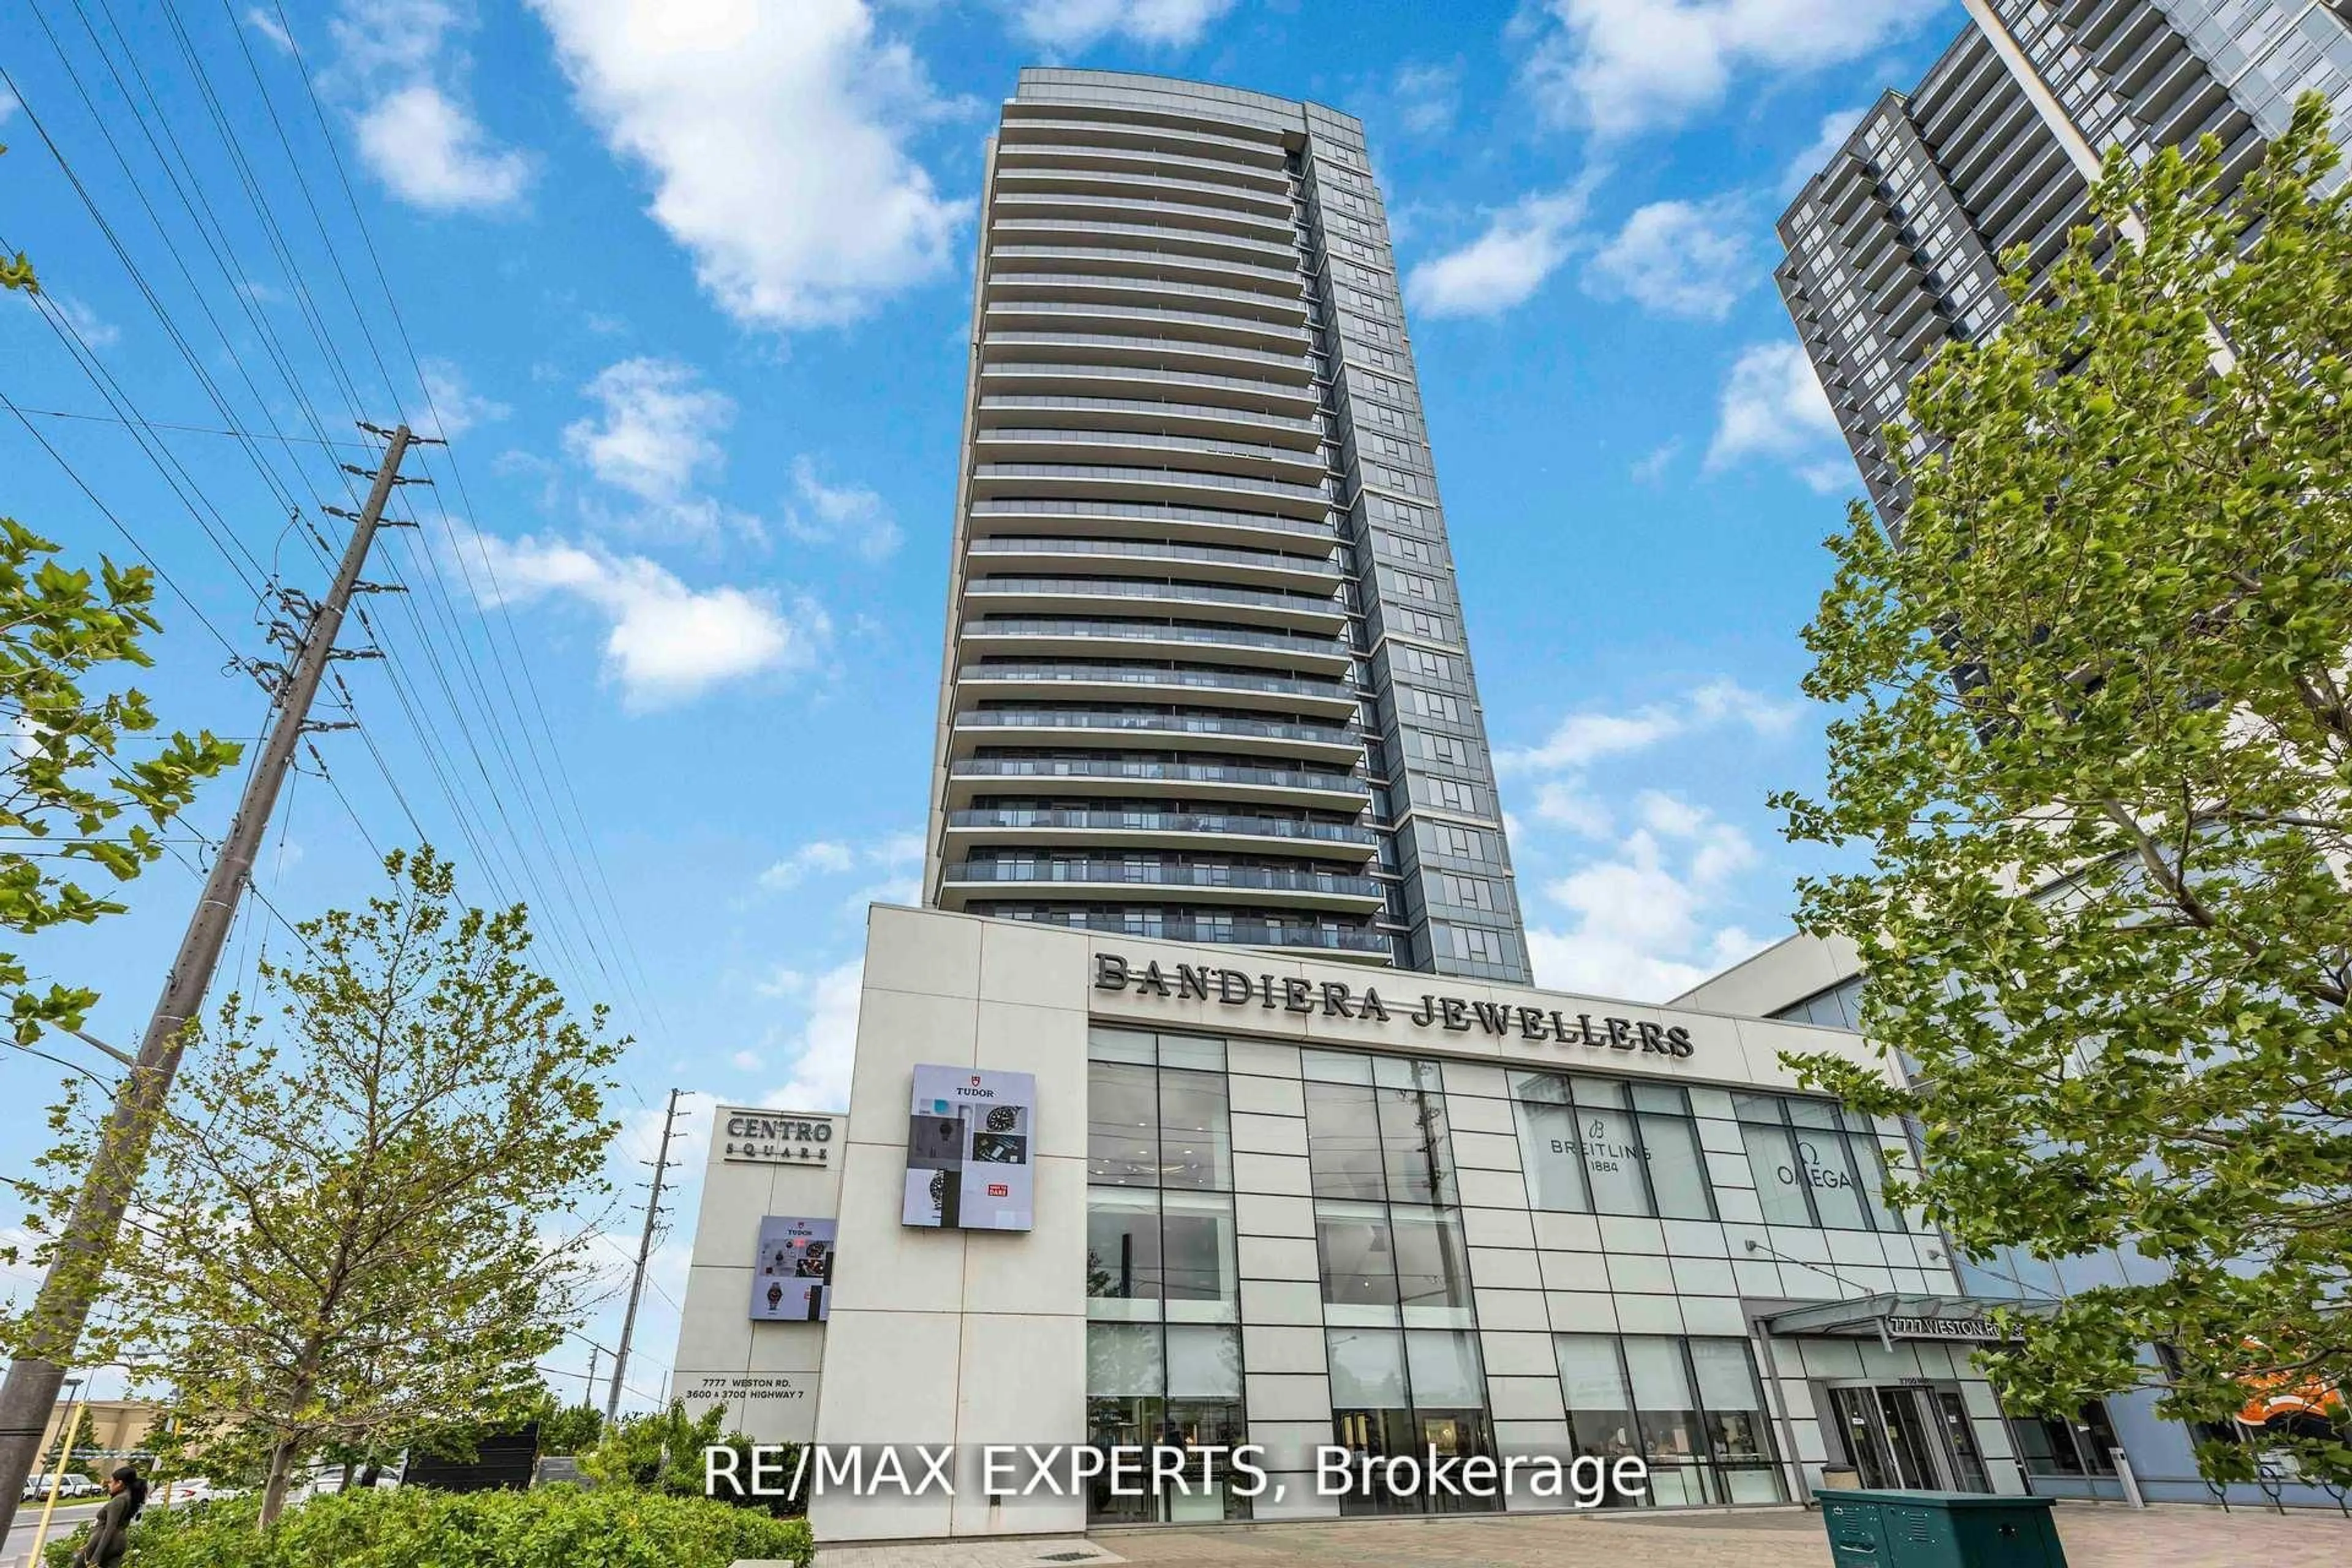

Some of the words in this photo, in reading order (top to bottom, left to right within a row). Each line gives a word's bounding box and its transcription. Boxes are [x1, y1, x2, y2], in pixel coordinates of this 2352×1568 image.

[1094, 952, 1390, 1021] BANDIERA
[1411, 995, 1694, 1057] JEWELLERS
[957, 1088, 994, 1098] TUDOR
[728, 1118, 832, 1142] CENTRO
[726, 1143, 826, 1160] SQUARE
[1591, 1161, 1618, 1172] 1884
[1890, 1318, 1923, 1333] 7777
[1924, 1319, 1984, 1335] WESTON
[775, 1379, 791, 1388] RD.
[686, 1390, 712, 1399] 3600
[722, 1390, 746, 1399] 3700
